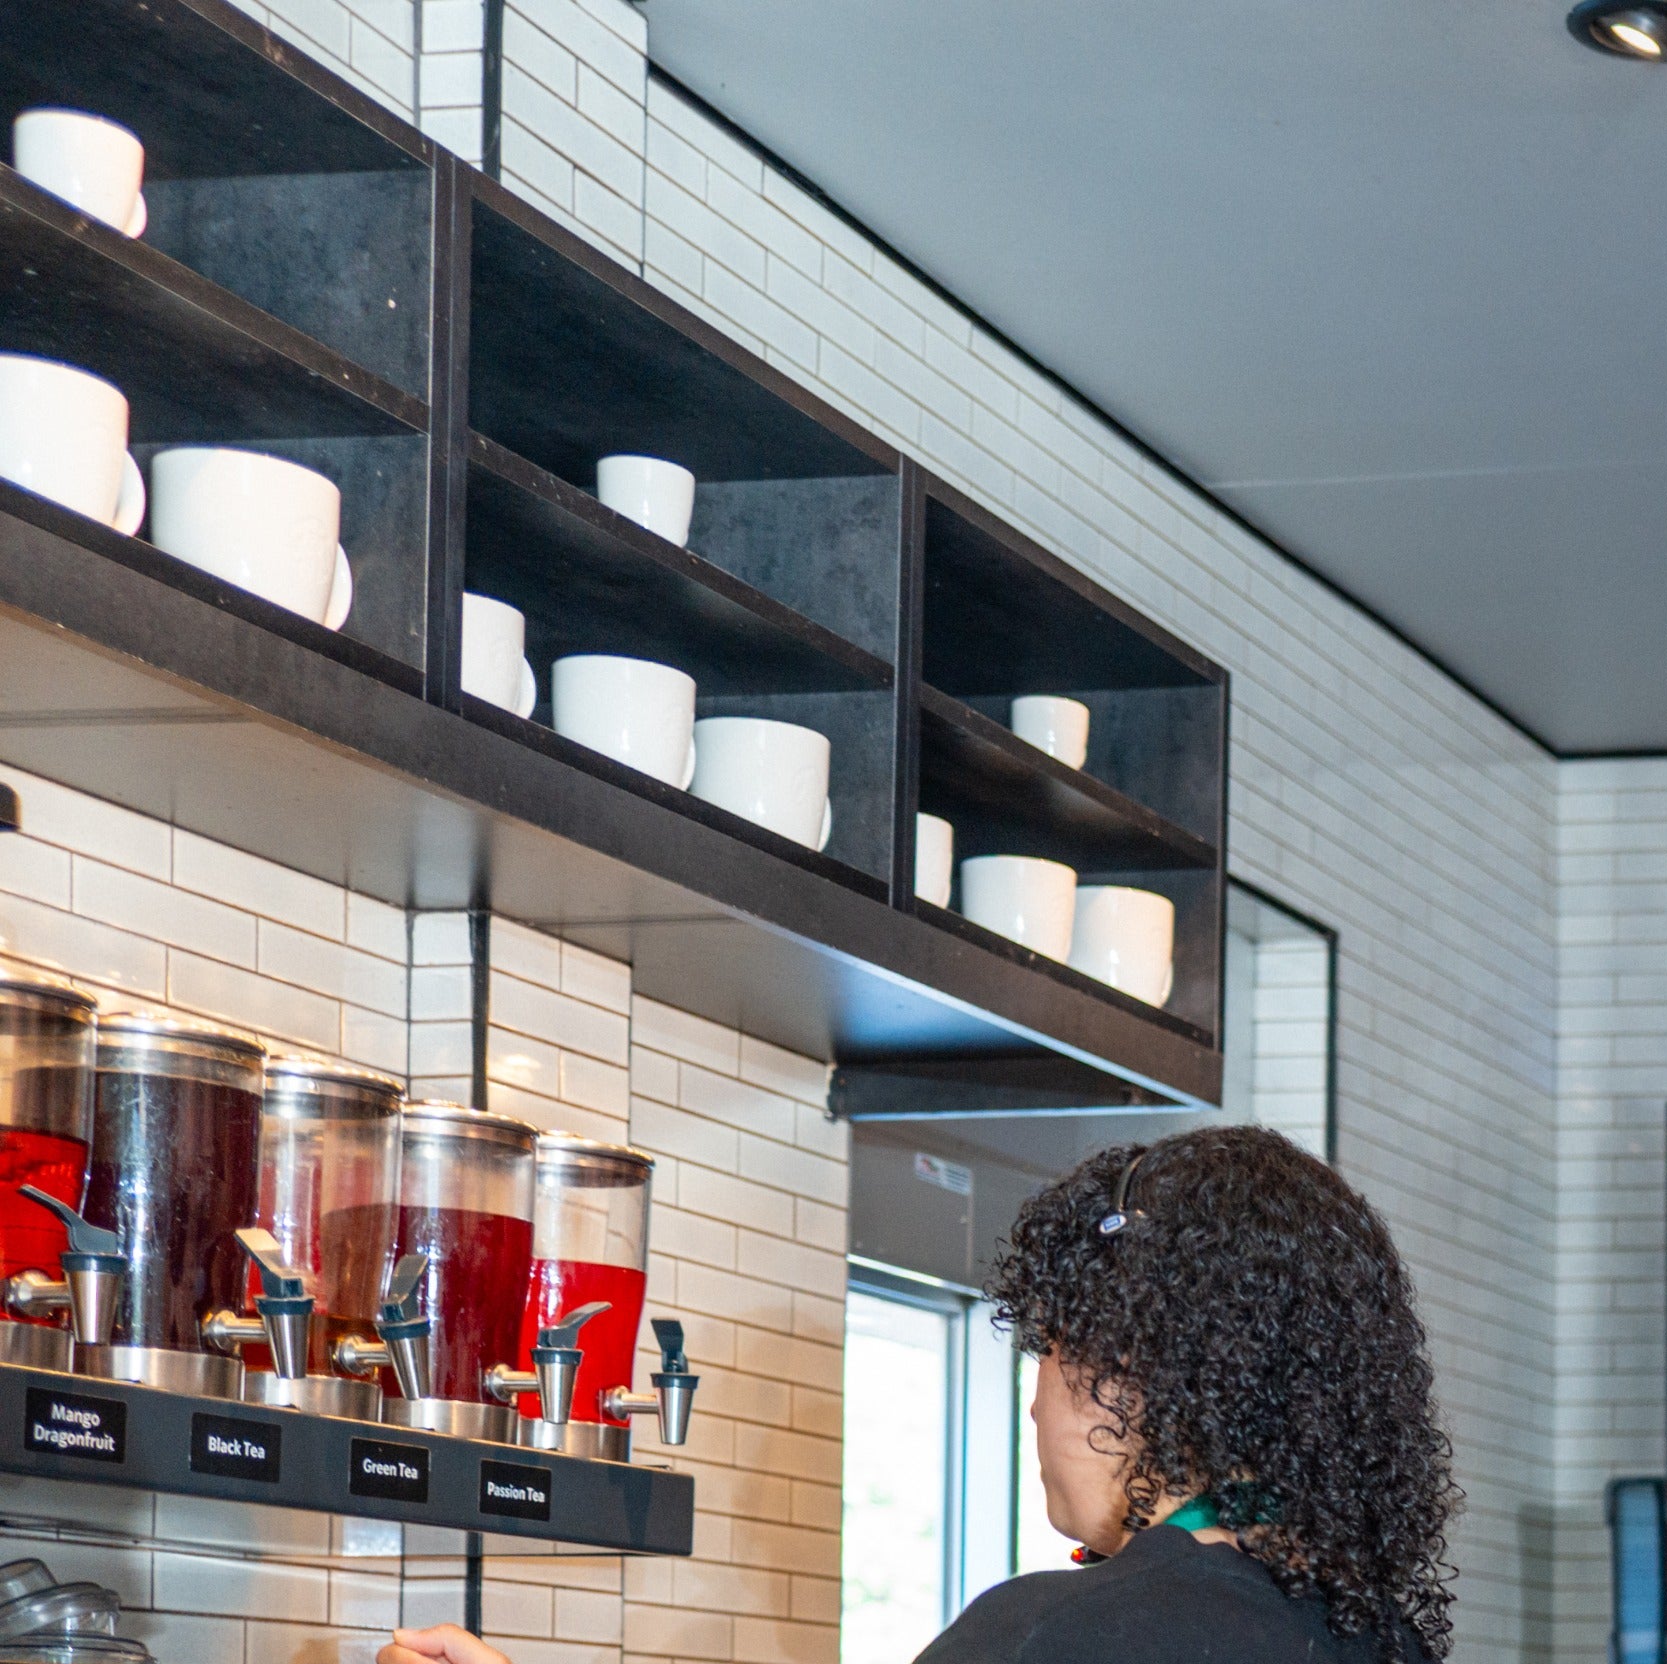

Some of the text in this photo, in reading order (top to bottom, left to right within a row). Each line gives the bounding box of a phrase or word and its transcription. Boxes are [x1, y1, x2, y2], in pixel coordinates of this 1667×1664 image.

[51, 1404, 100, 1428] Mango
[33, 1424, 115, 1451] Dragonfruit
[208, 1435, 265, 1459] Black Tea
[362, 1458, 419, 1480] Green Tea
[487, 1481, 546, 1503] Passion Tea
